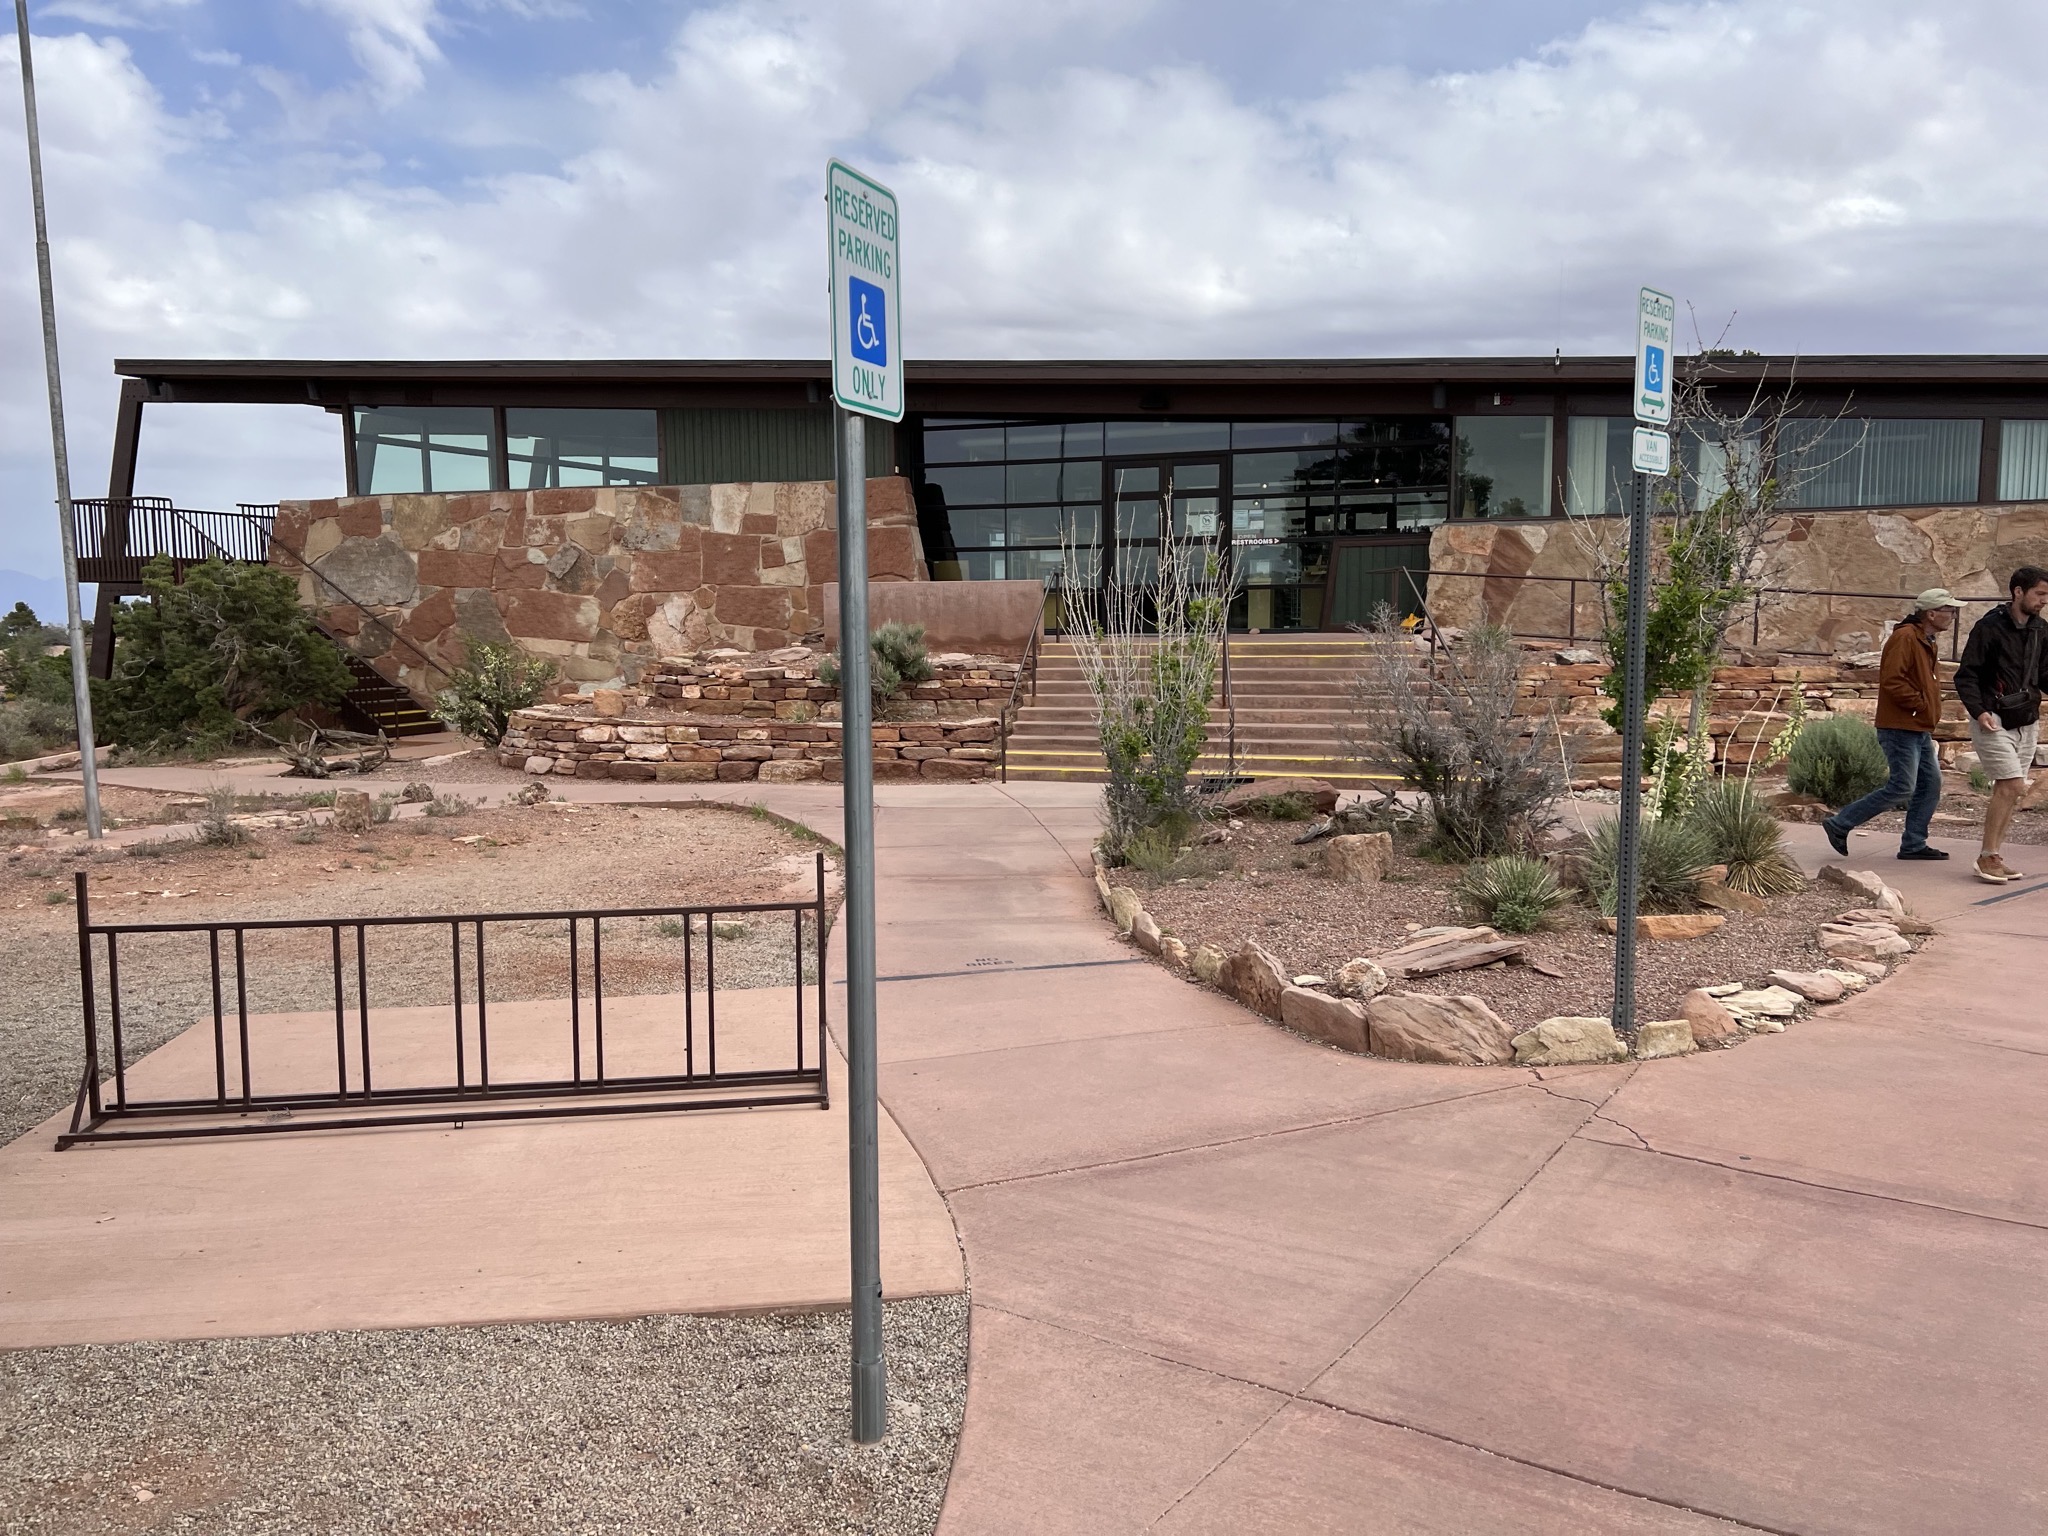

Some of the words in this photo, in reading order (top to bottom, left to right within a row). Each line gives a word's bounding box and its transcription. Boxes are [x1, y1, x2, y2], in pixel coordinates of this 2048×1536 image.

[834, 184, 895, 242] RESERVED
[838, 227, 891, 279] PARKING
[1641, 297, 1672, 321] RESERVED
[1643, 320, 1669, 343] PARKING
[852, 365, 886, 401] ONLY
[1645, 439, 1658, 452] VAN
[1639, 453, 1664, 465] ACCESSIBLE
